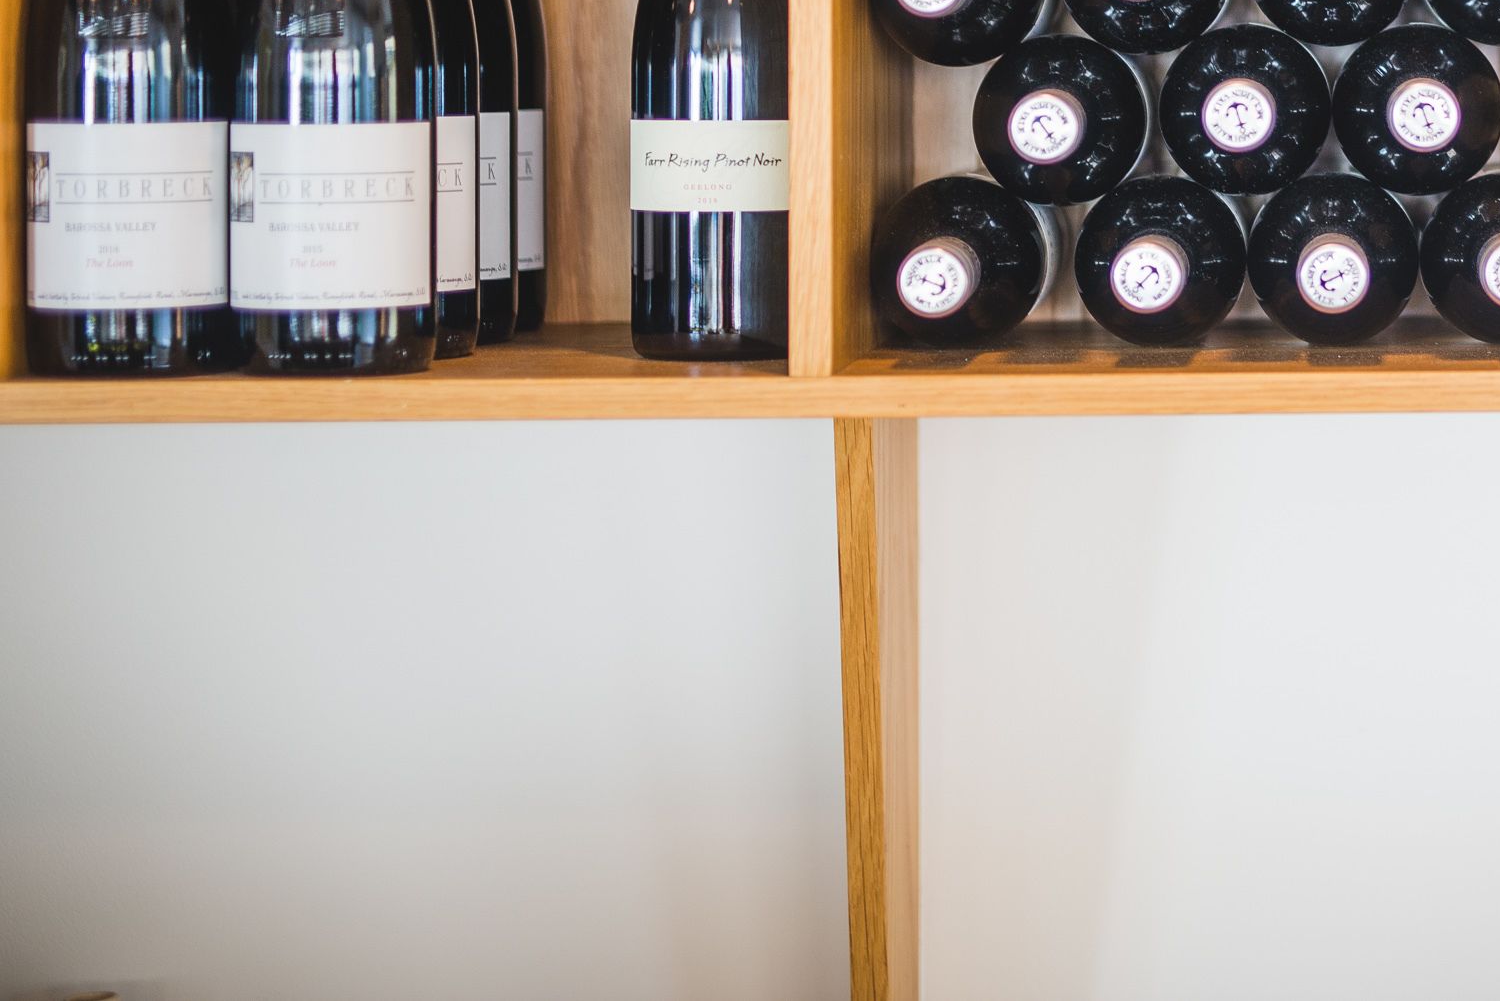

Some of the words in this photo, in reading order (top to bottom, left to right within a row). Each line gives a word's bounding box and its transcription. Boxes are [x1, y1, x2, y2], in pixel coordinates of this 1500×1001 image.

[645, 152, 665, 167] Farr
[668, 153, 710, 173] Rising
[714, 153, 751, 167] Pinot
[753, 152, 782, 167] Noir
[56, 176, 212, 199] TORBRECK
[260, 176, 415, 199] TORBRECK
[683, 183, 732, 191] GEELONG
[64, 221, 111, 232] BAROSSA
[115, 221, 157, 232] VALLEY
[318, 221, 360, 232] VALLEY
[85, 258, 104, 269] The
[289, 258, 308, 269] The
